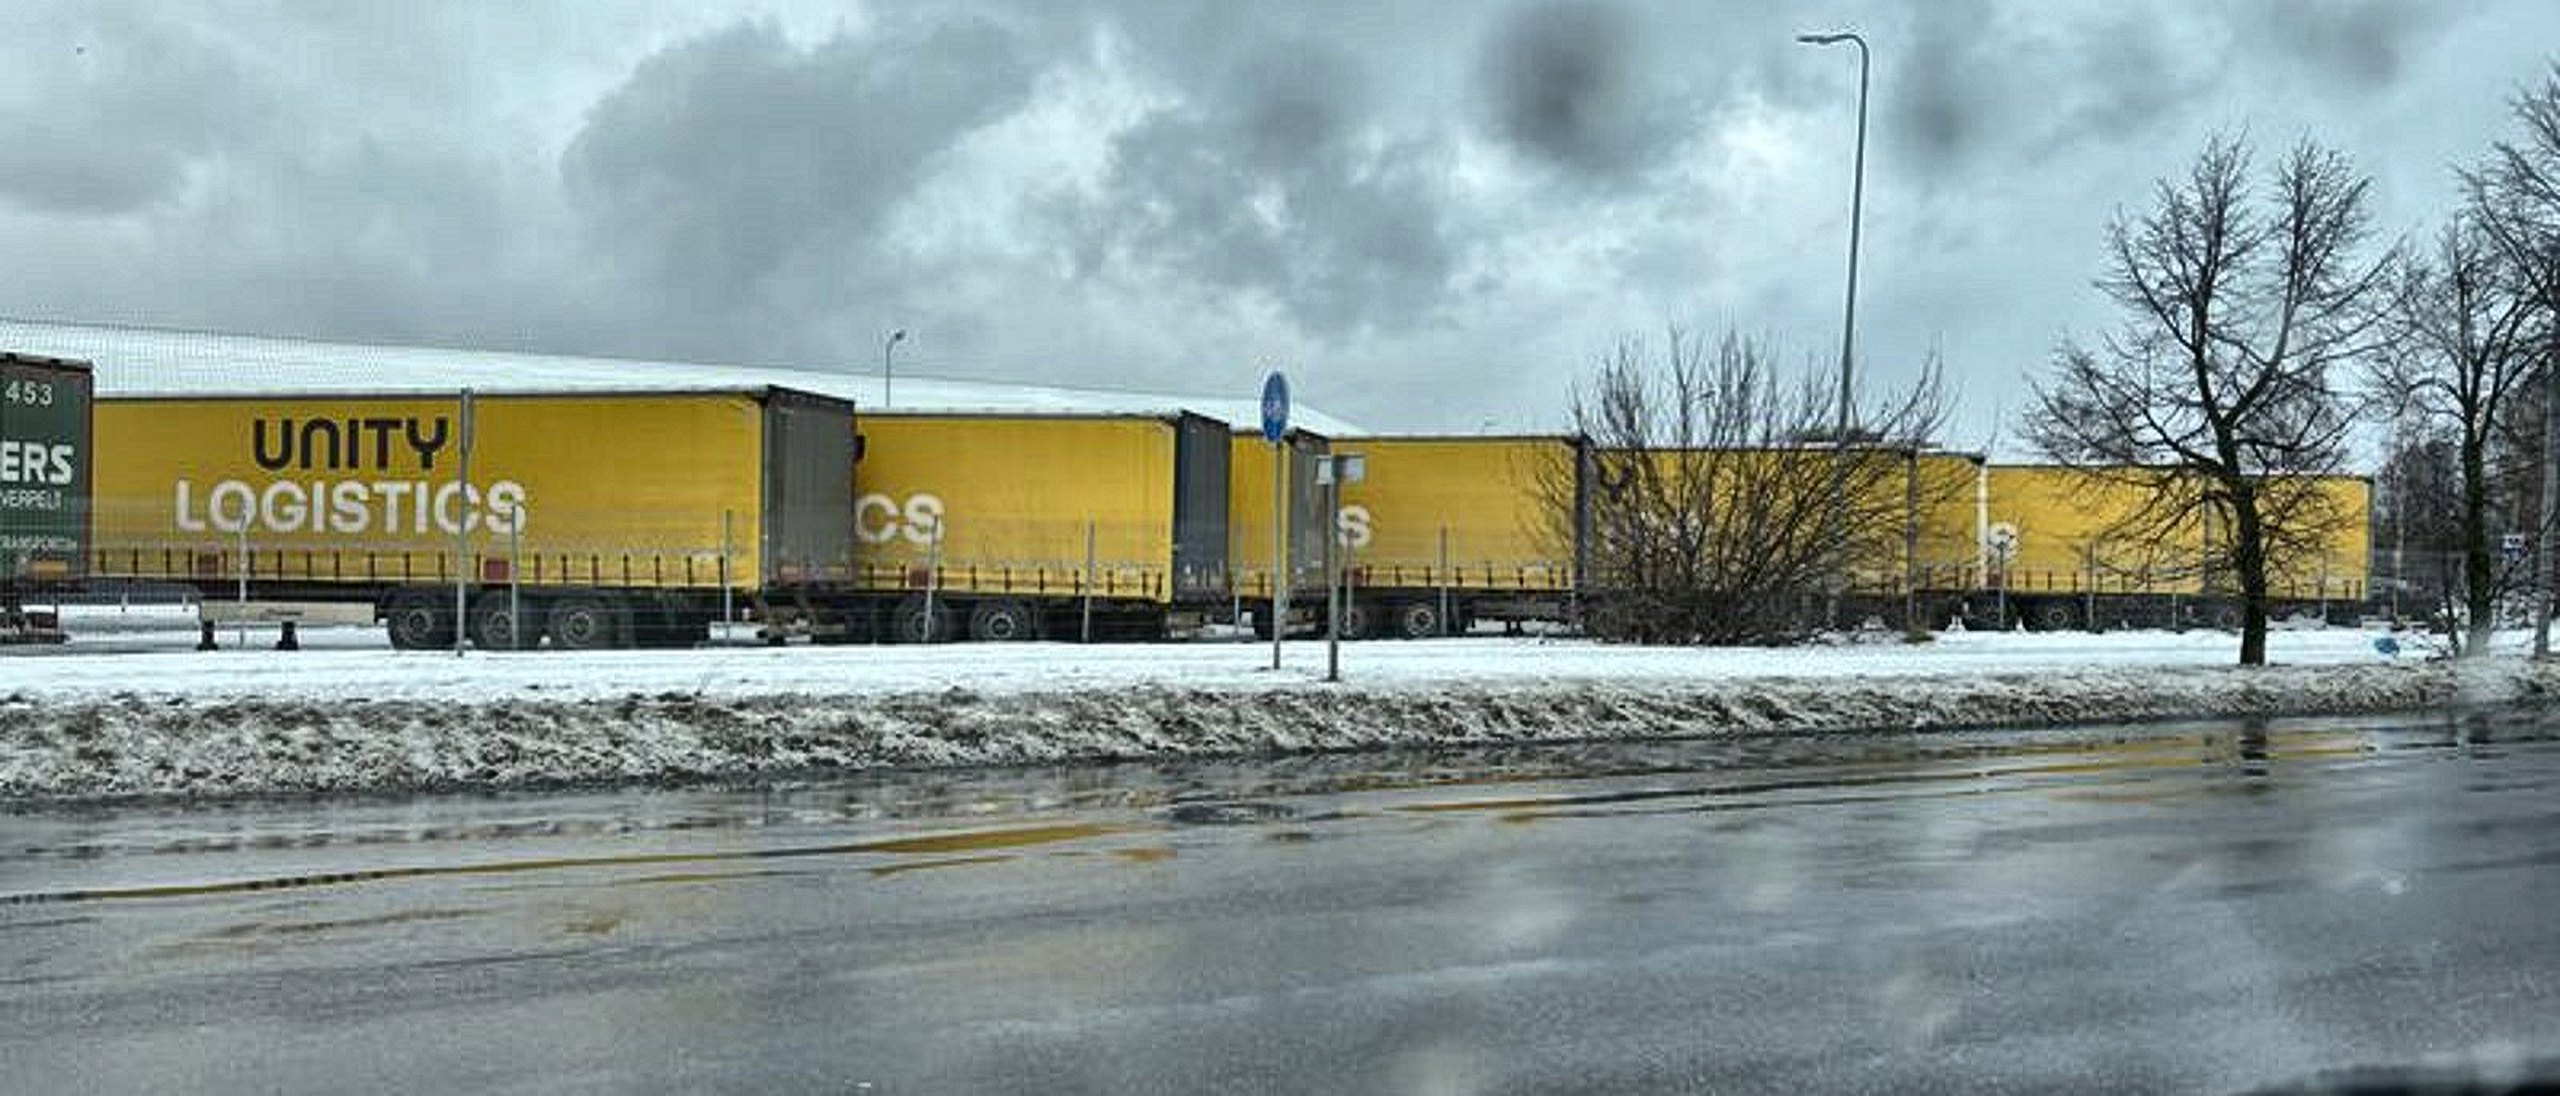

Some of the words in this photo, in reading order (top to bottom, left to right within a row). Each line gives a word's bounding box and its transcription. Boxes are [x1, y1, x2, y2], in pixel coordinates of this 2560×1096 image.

[5, 381, 53, 405] 453
[0, 441, 74, 485] ERS
[254, 417, 449, 471] UNITY
[176, 480, 526, 535] LOGISTICS
[855, 494, 944, 543] CS
